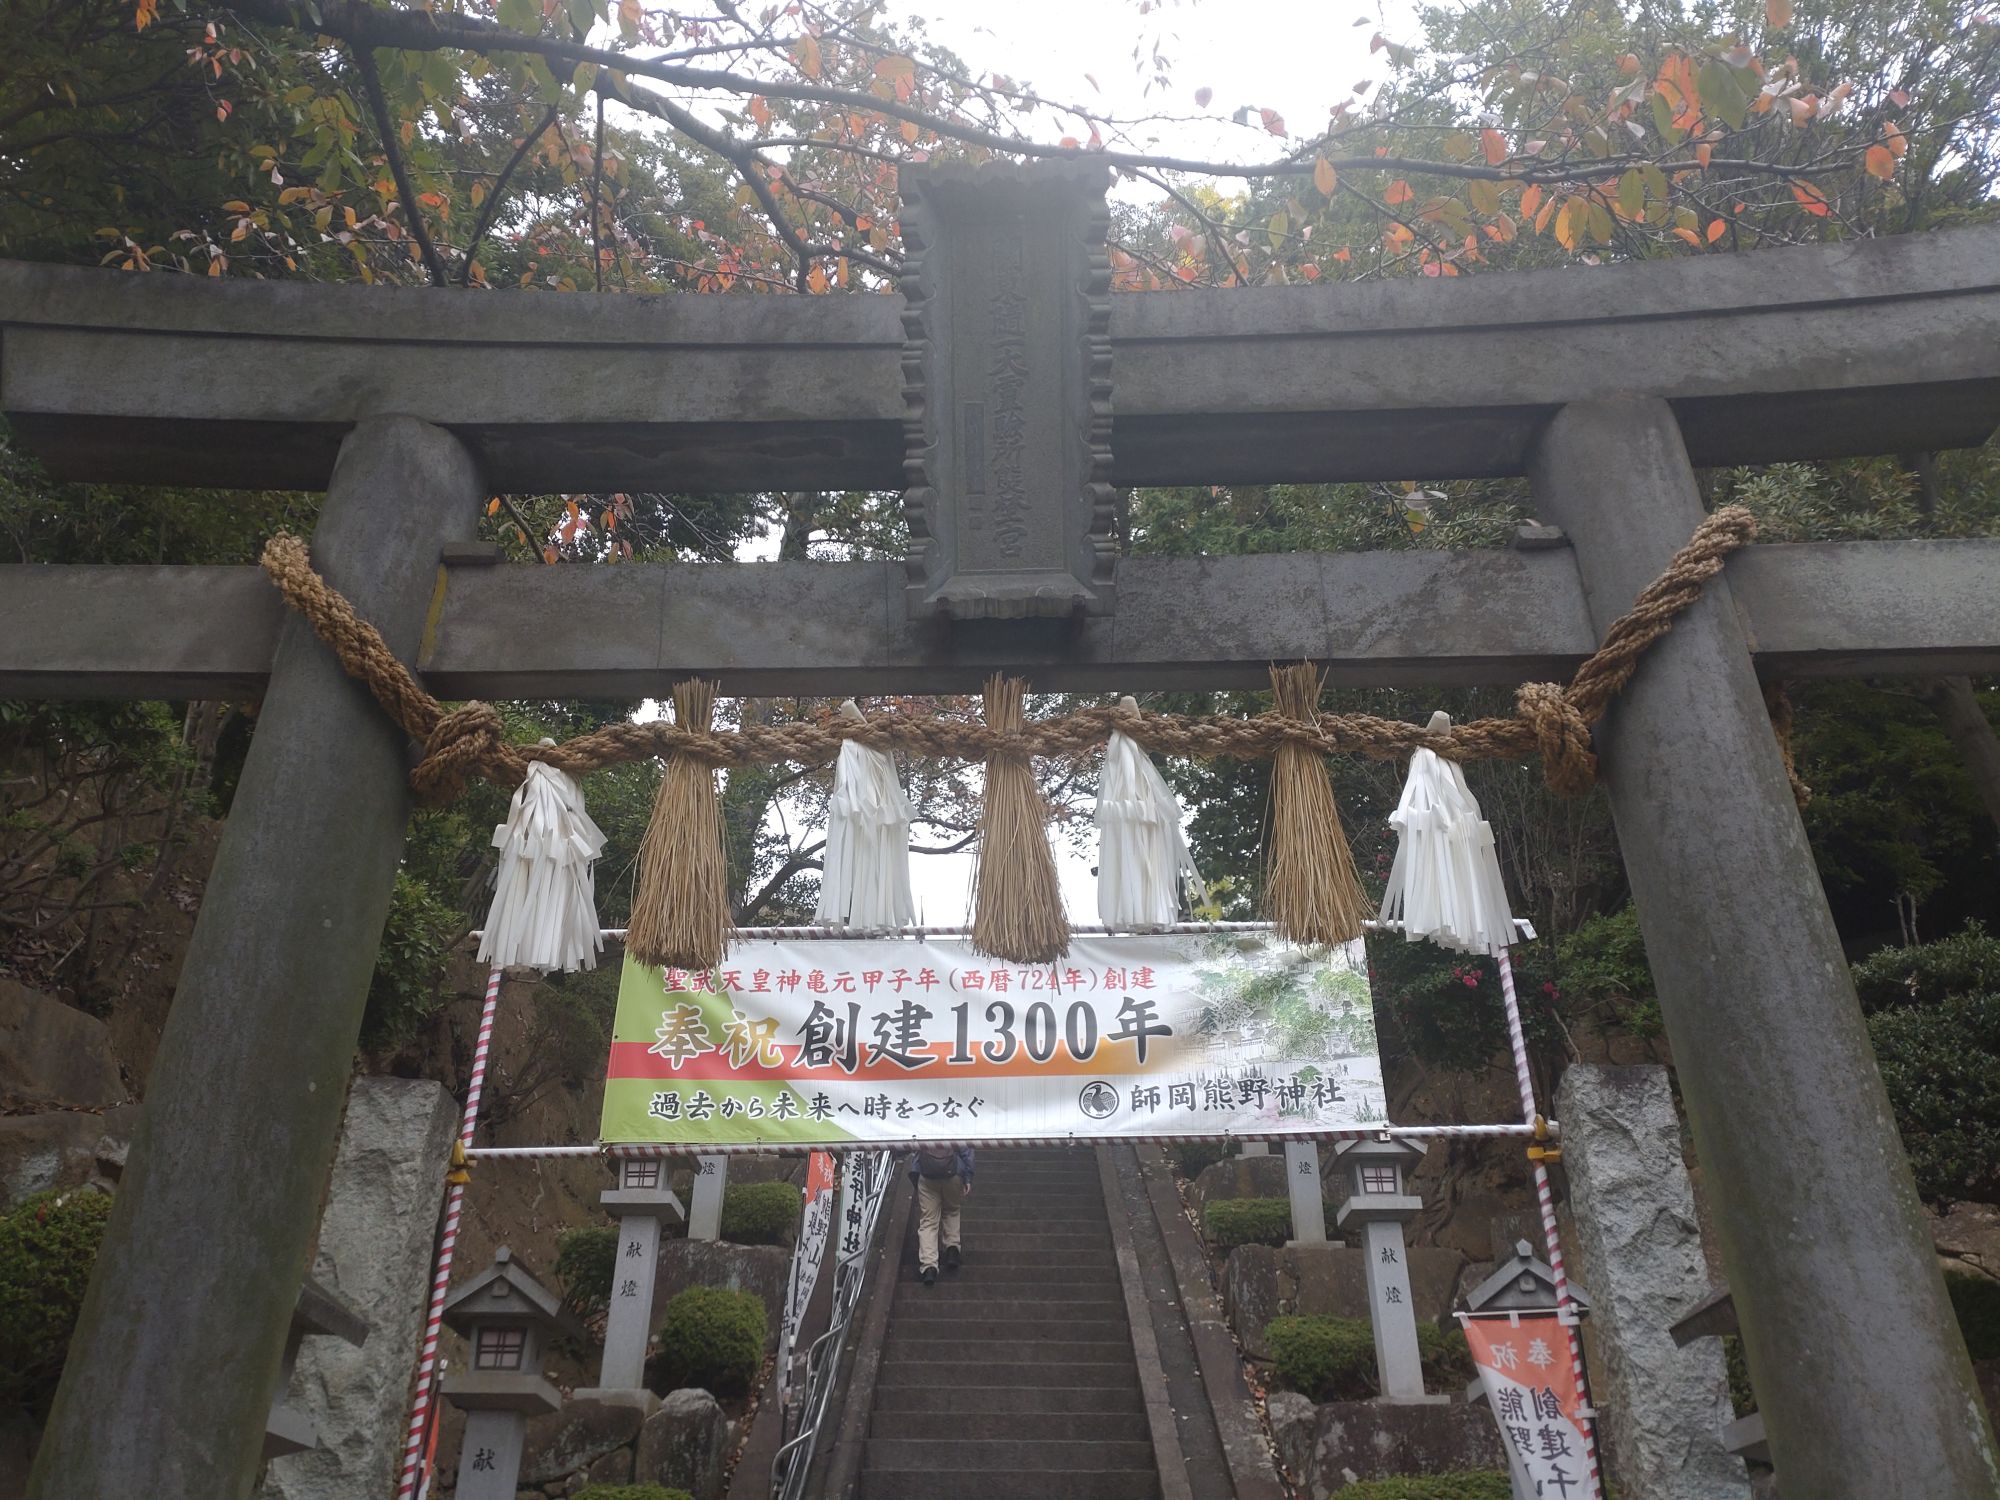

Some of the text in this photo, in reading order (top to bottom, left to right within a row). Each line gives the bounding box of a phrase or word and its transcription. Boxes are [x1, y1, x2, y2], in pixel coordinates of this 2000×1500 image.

[650, 1091, 985, 1121] 過去から未来へ時をつなぐ
[1131, 1076, 1346, 1114] 師岡熊野神社
[472, 1447, 496, 1473] 献
